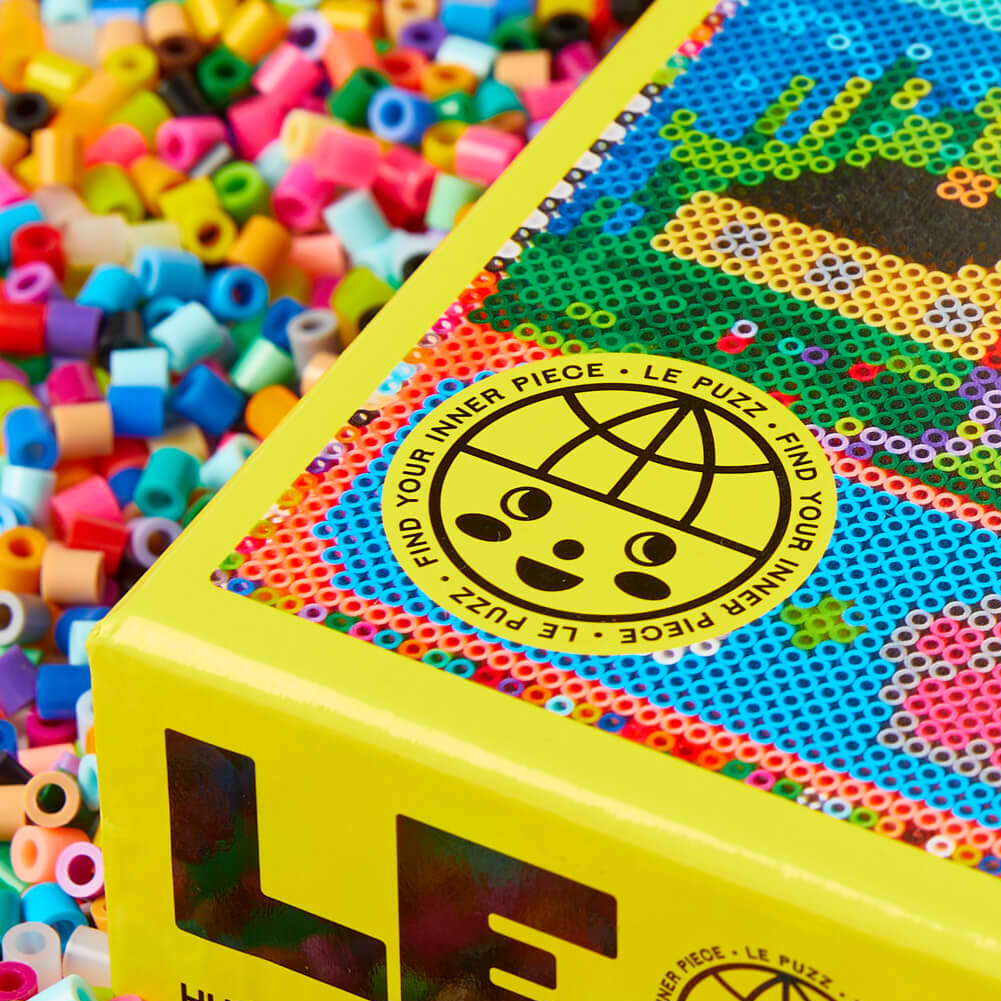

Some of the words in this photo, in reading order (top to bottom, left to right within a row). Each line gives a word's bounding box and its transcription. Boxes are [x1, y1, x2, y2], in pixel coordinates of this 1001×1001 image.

[511, 362, 604, 392] PIECE
[643, 364, 682, 384] LE
[692, 376, 769, 418] PUZZ
[425, 387, 506, 443] INNER
[396, 448, 434, 507] YOUR
[775, 431, 818, 481] FIND
[399, 517, 439, 568] FIND
[788, 491, 822, 552] YOUR
[449, 586, 528, 631] PUZZ
[720, 558, 799, 616] INNER
[537, 622, 578, 643] LE
[619, 612, 715, 644] PIECE
[677, 945, 725, 973] PIECE
[745, 945, 771, 962] LE
[779, 954, 833, 990] PUZZ
